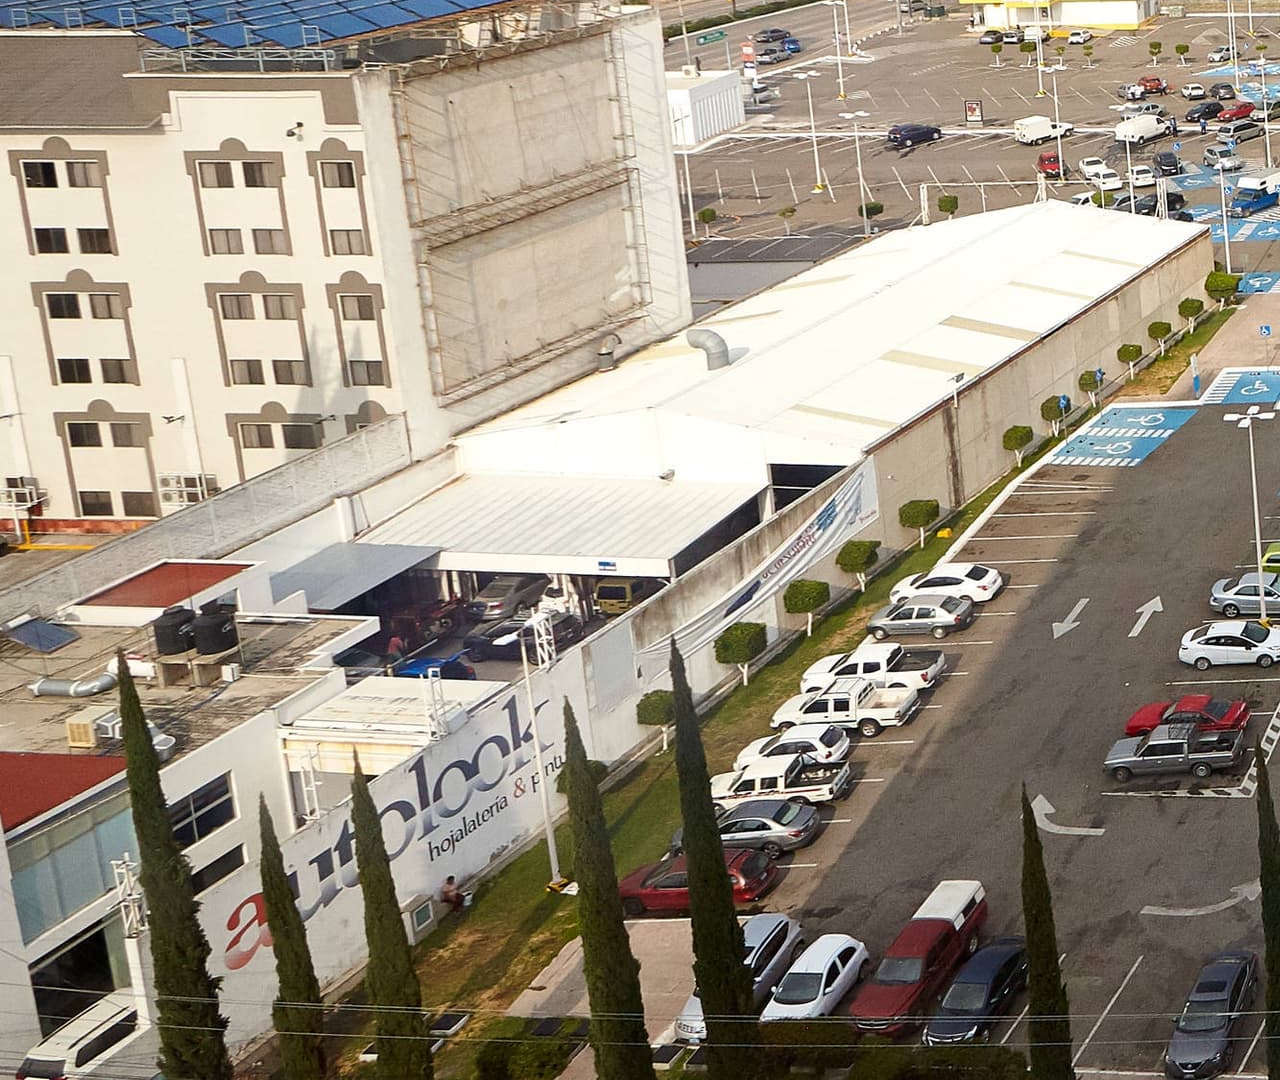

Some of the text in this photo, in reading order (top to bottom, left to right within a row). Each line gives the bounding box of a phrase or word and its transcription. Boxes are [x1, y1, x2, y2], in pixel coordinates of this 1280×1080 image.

[225, 694, 555, 970] autolook
[428, 794, 508, 861] hojalatería
[513, 777, 526, 799] &
